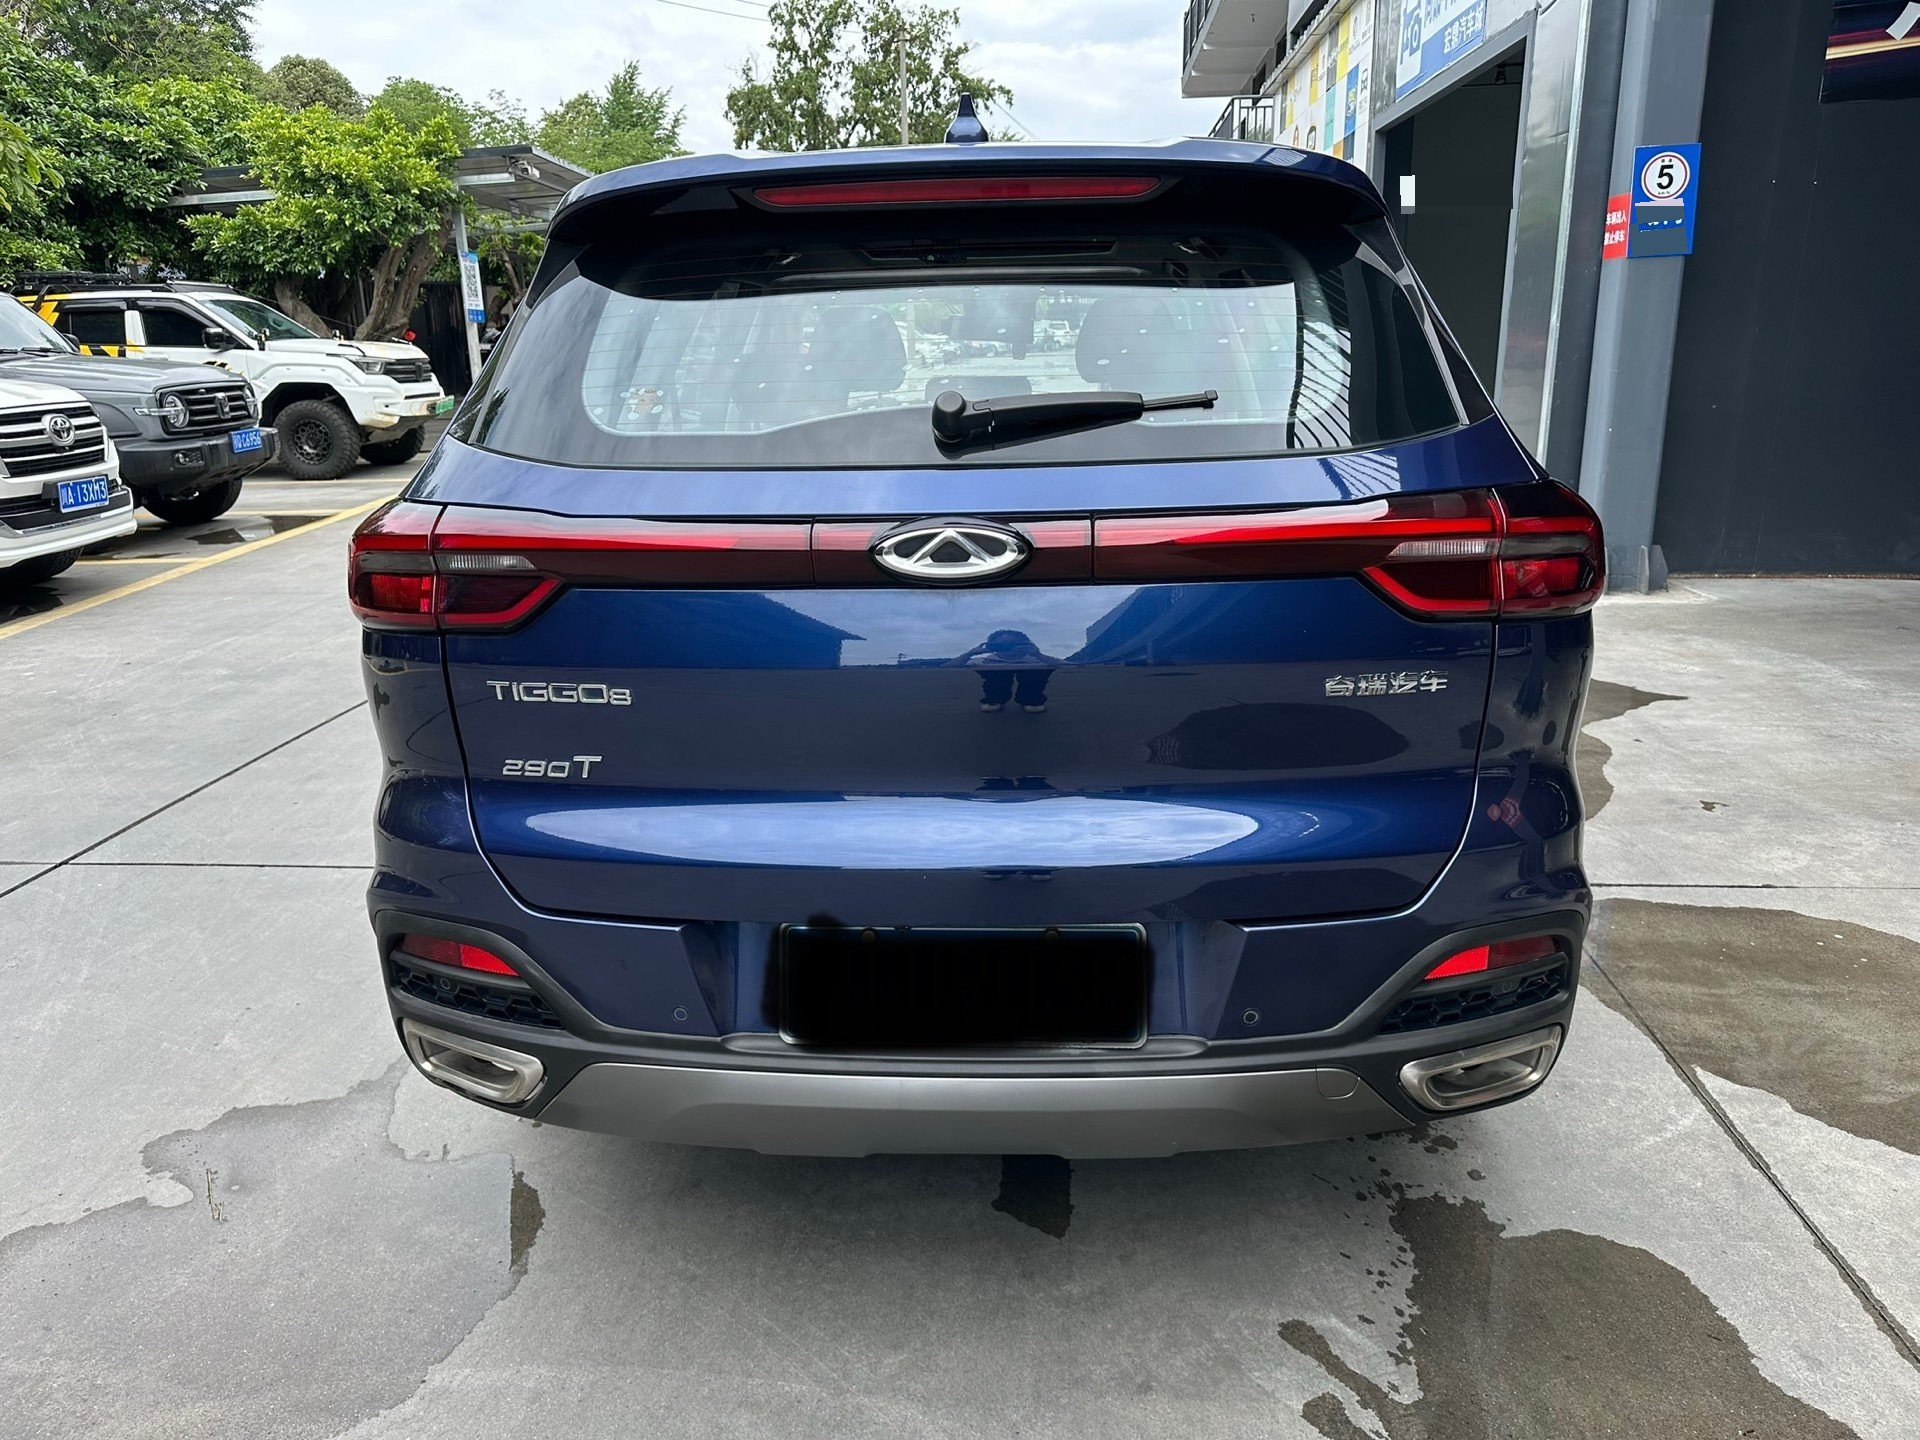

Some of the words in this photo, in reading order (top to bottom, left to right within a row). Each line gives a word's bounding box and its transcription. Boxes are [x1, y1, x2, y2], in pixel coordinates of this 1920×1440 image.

[1657, 164, 1674, 190] 5
[1325, 669, 1448, 697] 奇瑞汽车
[502, 755, 603, 778] 290T
